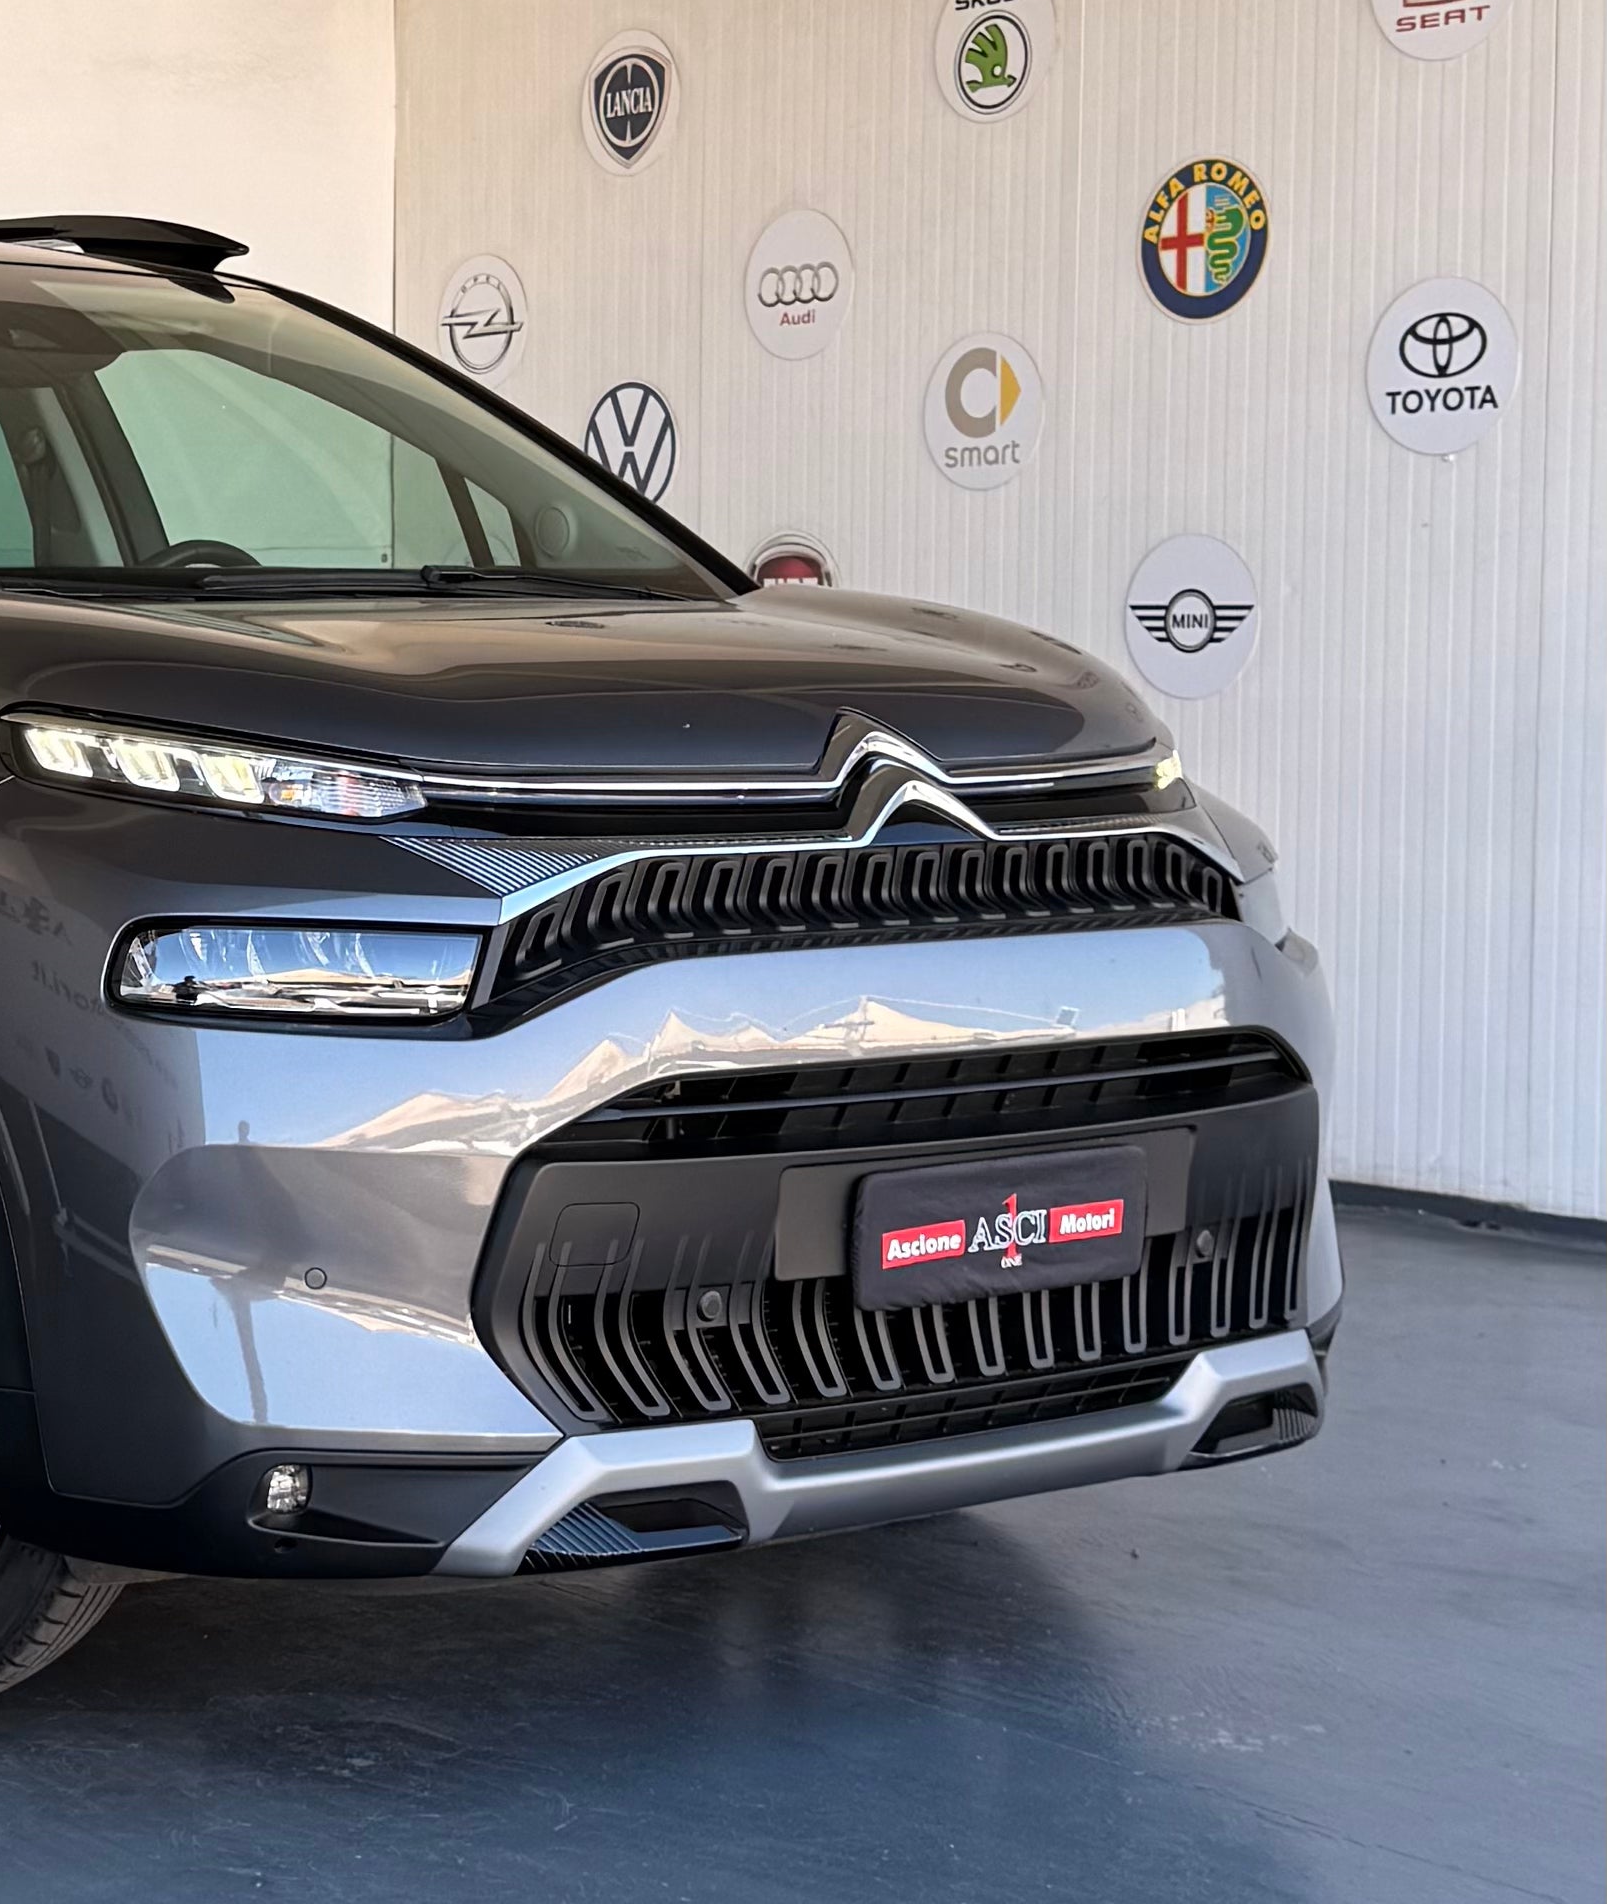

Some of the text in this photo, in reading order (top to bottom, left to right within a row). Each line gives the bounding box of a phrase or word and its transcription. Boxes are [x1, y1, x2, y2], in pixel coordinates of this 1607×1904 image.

[1395, 5, 1491, 32] SEAT
[606, 86, 653, 118] LANCIA
[1143, 162, 1266, 244] ALFA ROMEO
[779, 309, 816, 327] Audi
[1385, 384, 1499, 415] TOYOTA
[944, 440, 1021, 469] smart
[1171, 613, 1209, 629] MINI
[968, 1209, 1048, 1253] ASCI
[1059, 1208, 1115, 1235] Motori
[887, 1233, 962, 1261] Ascione
[1000, 1255, 1023, 1269] ONE
